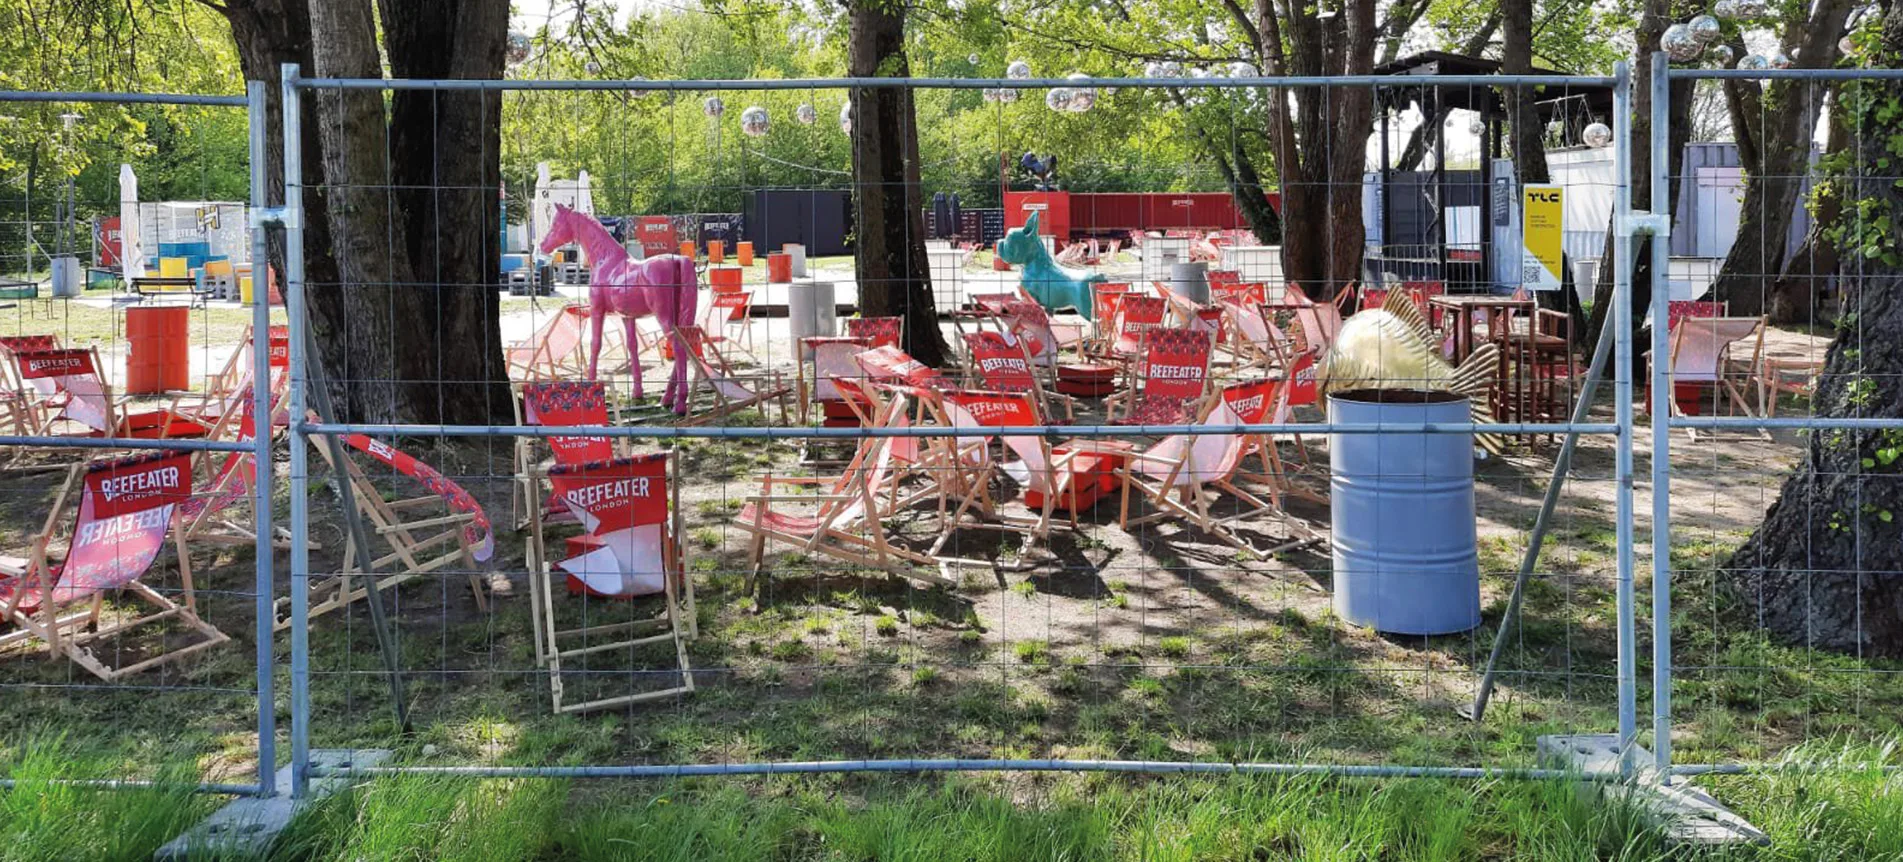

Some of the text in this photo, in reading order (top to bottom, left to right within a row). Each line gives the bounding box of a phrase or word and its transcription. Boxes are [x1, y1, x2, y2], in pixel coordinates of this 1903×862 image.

[1528, 193, 1559, 202] TLC
[30, 358, 82, 373] BEEFEATER
[981, 358, 1027, 374] BEEFEATER
[1150, 365, 1202, 382] BEEFEATER
[962, 401, 1019, 415] EEFEATER
[101, 466, 179, 502] BEEFEATER
[122, 488, 162, 502] LONDON
[567, 477, 649, 507] BEEFEATER
[589, 500, 629, 513] LONDON
